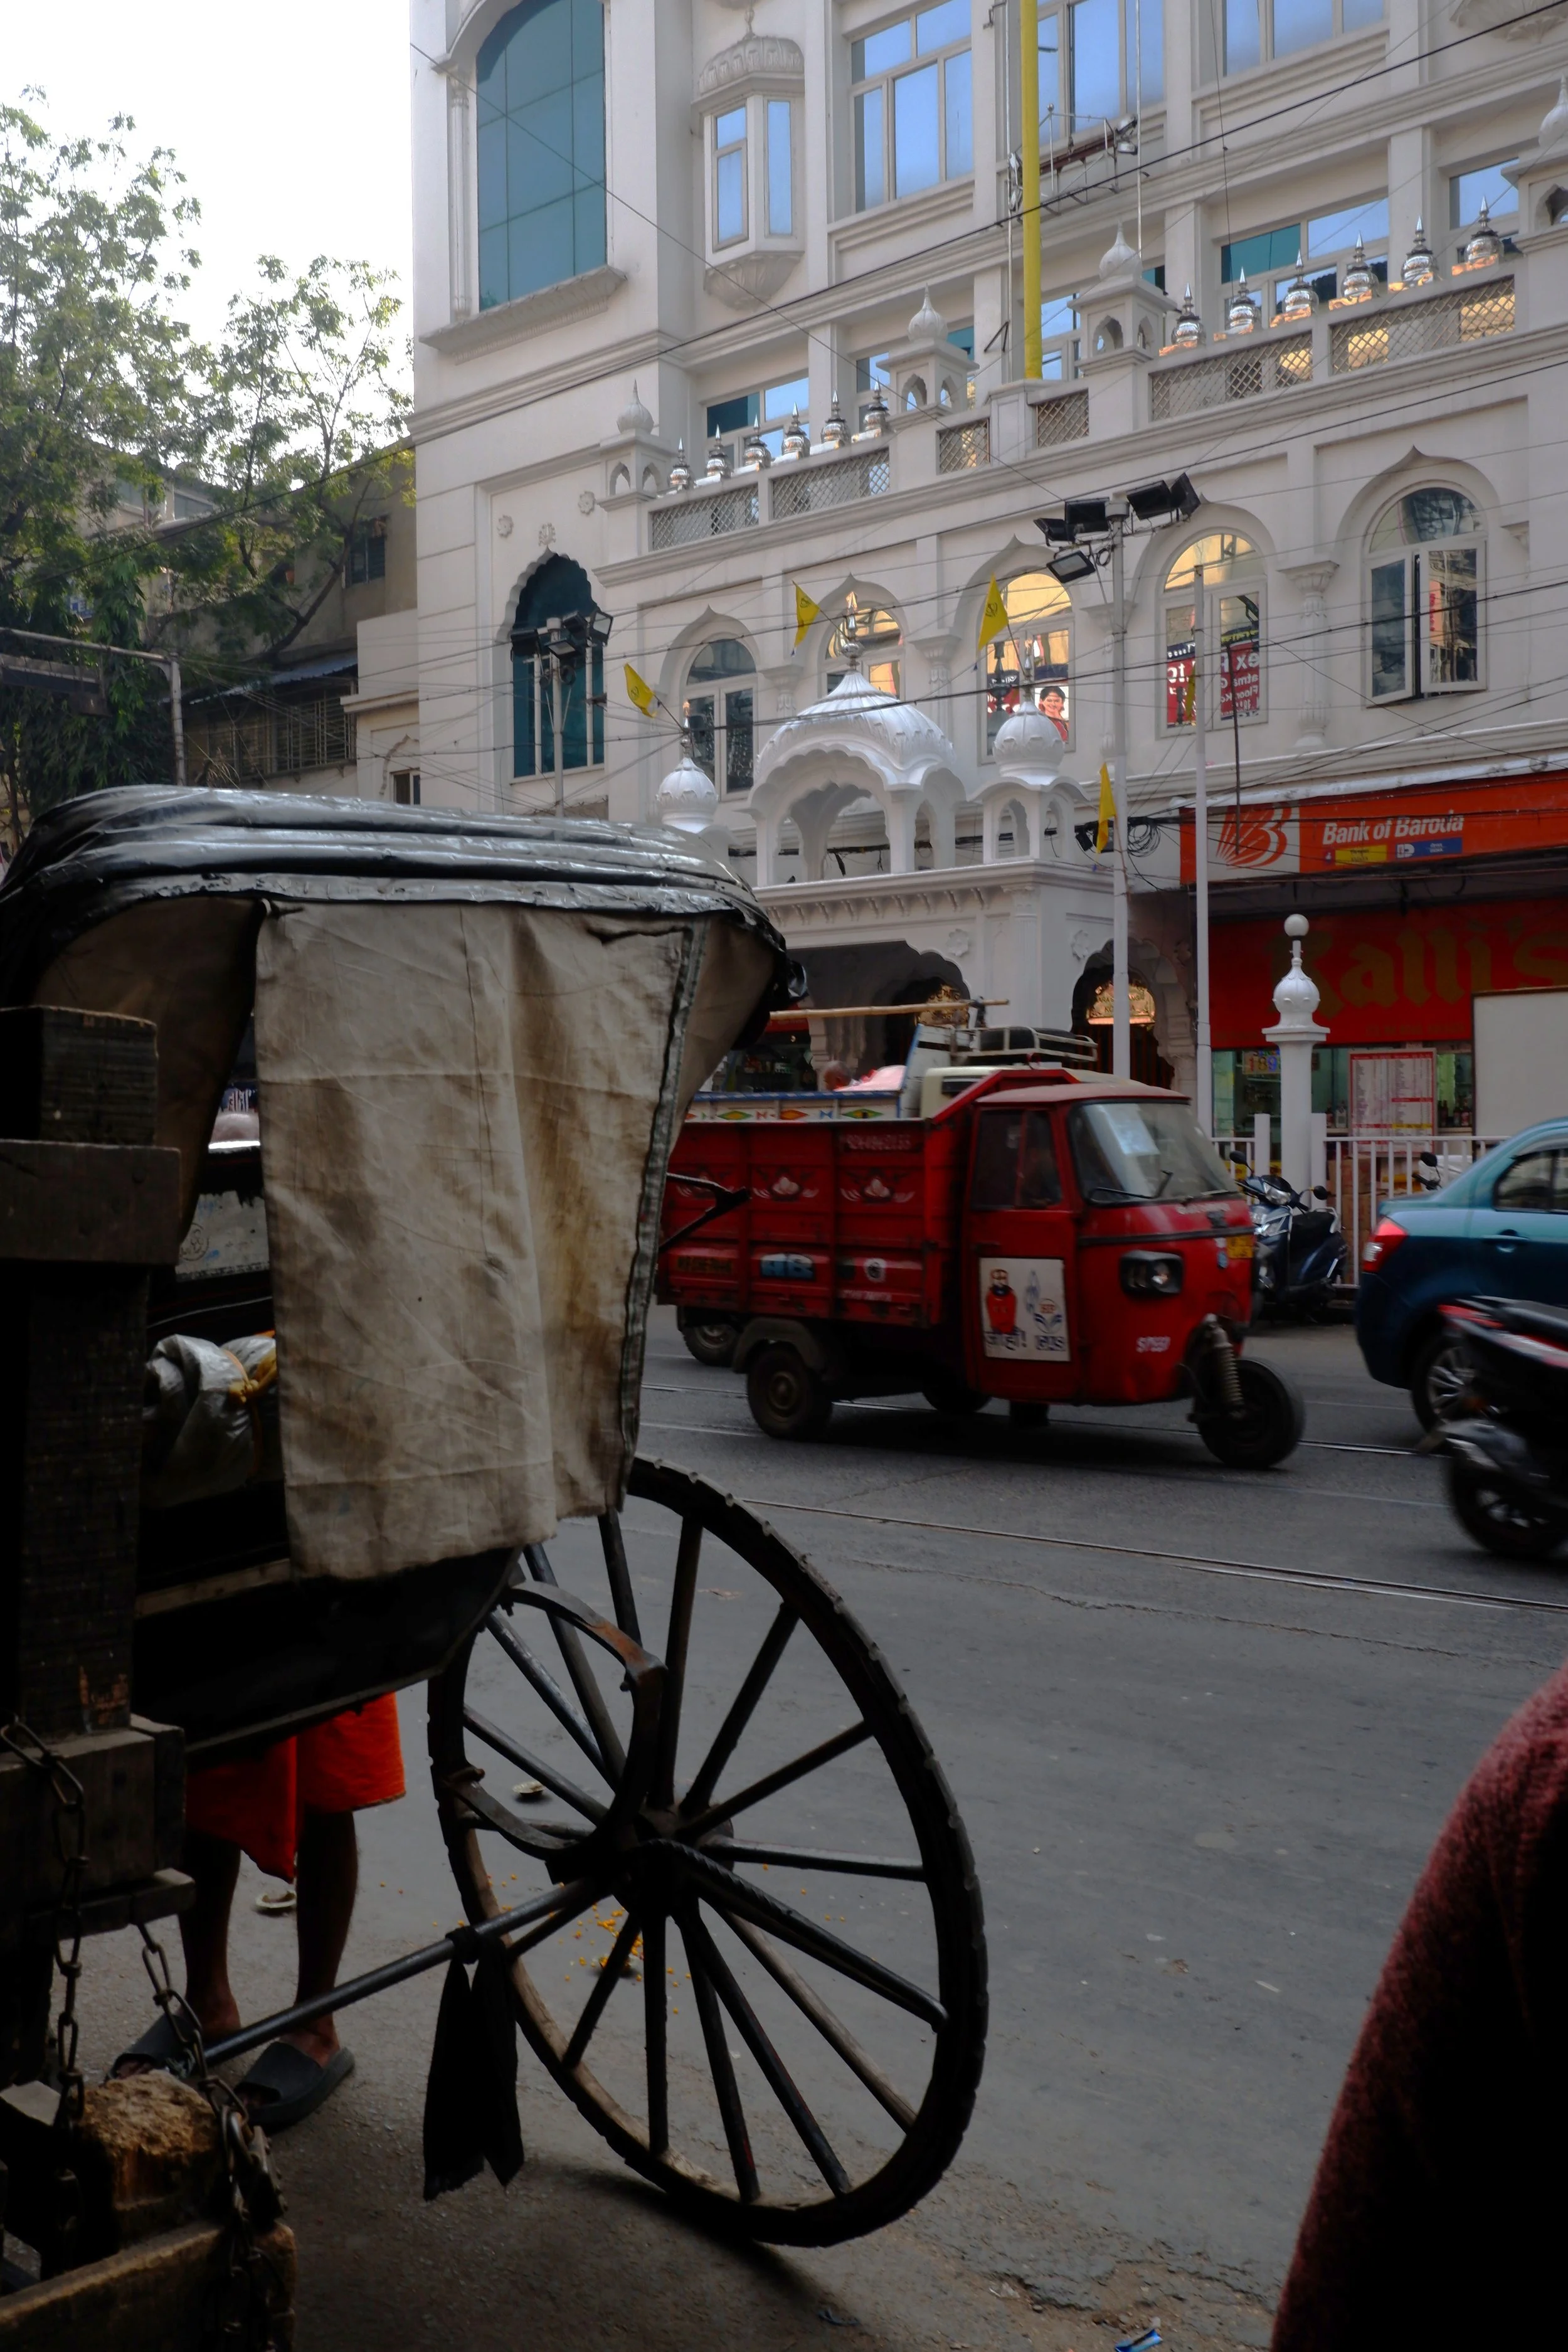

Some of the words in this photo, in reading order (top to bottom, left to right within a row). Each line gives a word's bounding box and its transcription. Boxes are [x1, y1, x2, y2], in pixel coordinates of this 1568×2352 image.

[1323, 820, 1371, 845] Bank
[1373, 818, 1393, 840] of
[1395, 808, 1465, 838] Baroda
